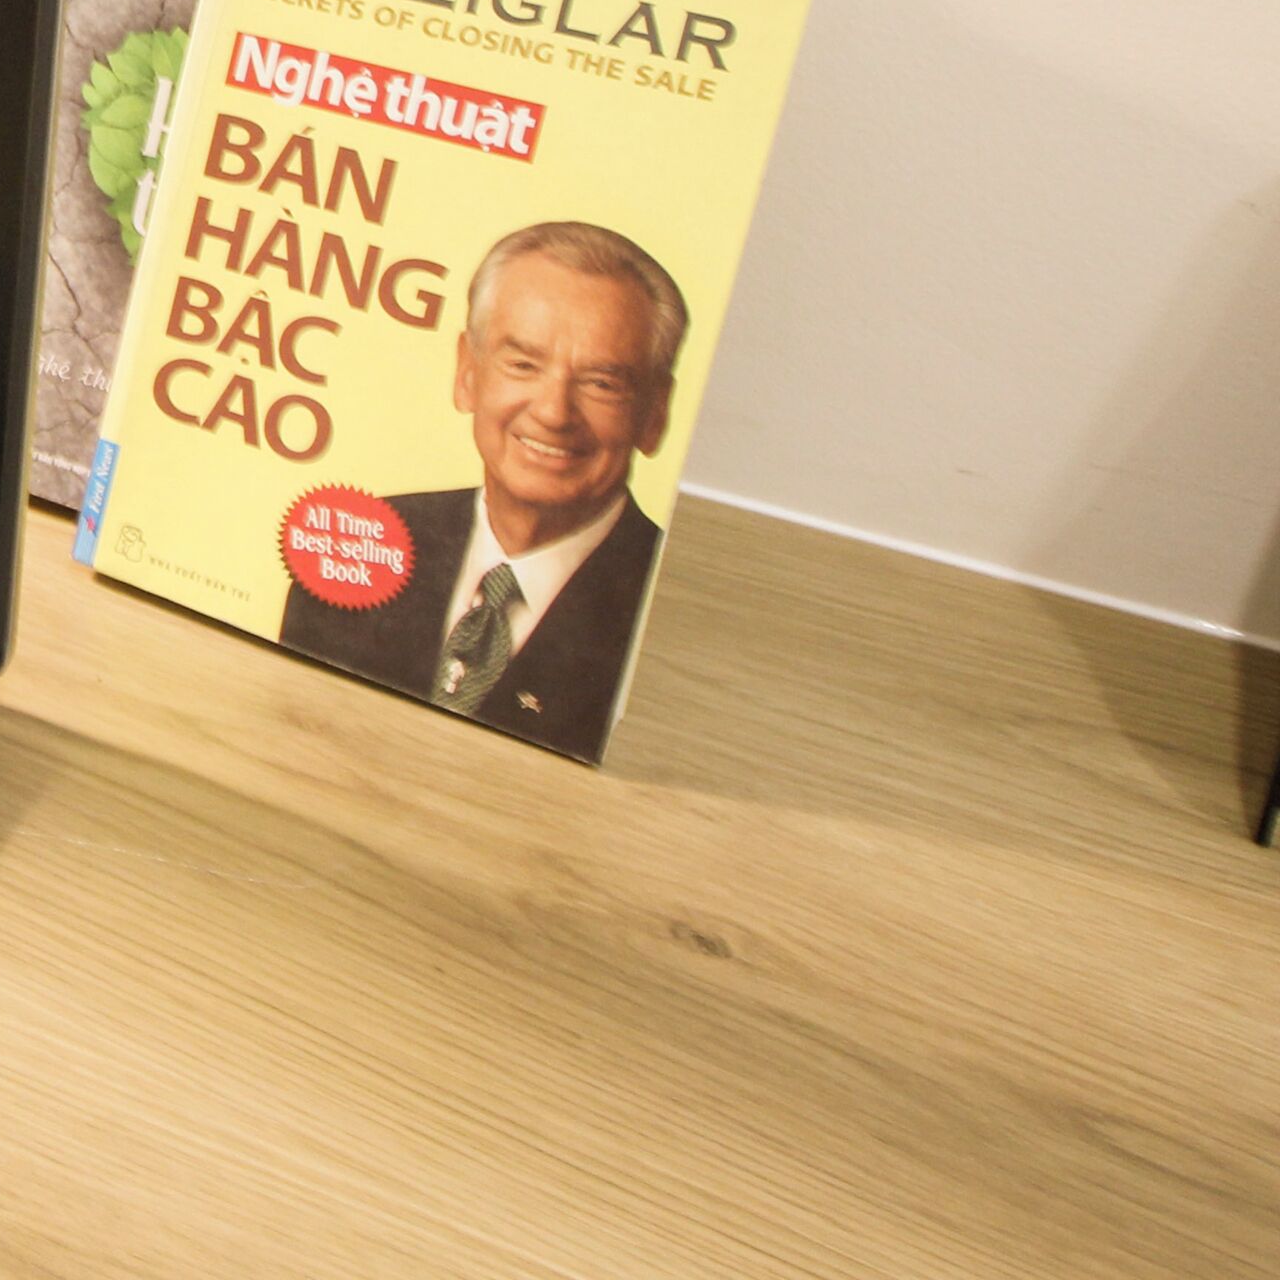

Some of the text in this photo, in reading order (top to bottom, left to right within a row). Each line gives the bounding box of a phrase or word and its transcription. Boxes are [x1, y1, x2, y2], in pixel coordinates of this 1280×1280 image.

[232, 33, 378, 119] Nghệ
[384, 73, 537, 154] thuật
[373, 5, 416, 31] OF
[422, 17, 556, 65] CLOSING
[565, 48, 626, 81] THE
[633, 64, 718, 102] SALE
[203, 112, 399, 227] BÁN
[184, 195, 450, 332] HÀNG
[165, 275, 344, 388] BẬC
[152, 357, 335, 466] CAO
[95, 446, 116, 482] News
[290, 526, 405, 575] Best-selling
[304, 504, 385, 539] All Time
[321, 555, 373, 588] Book
